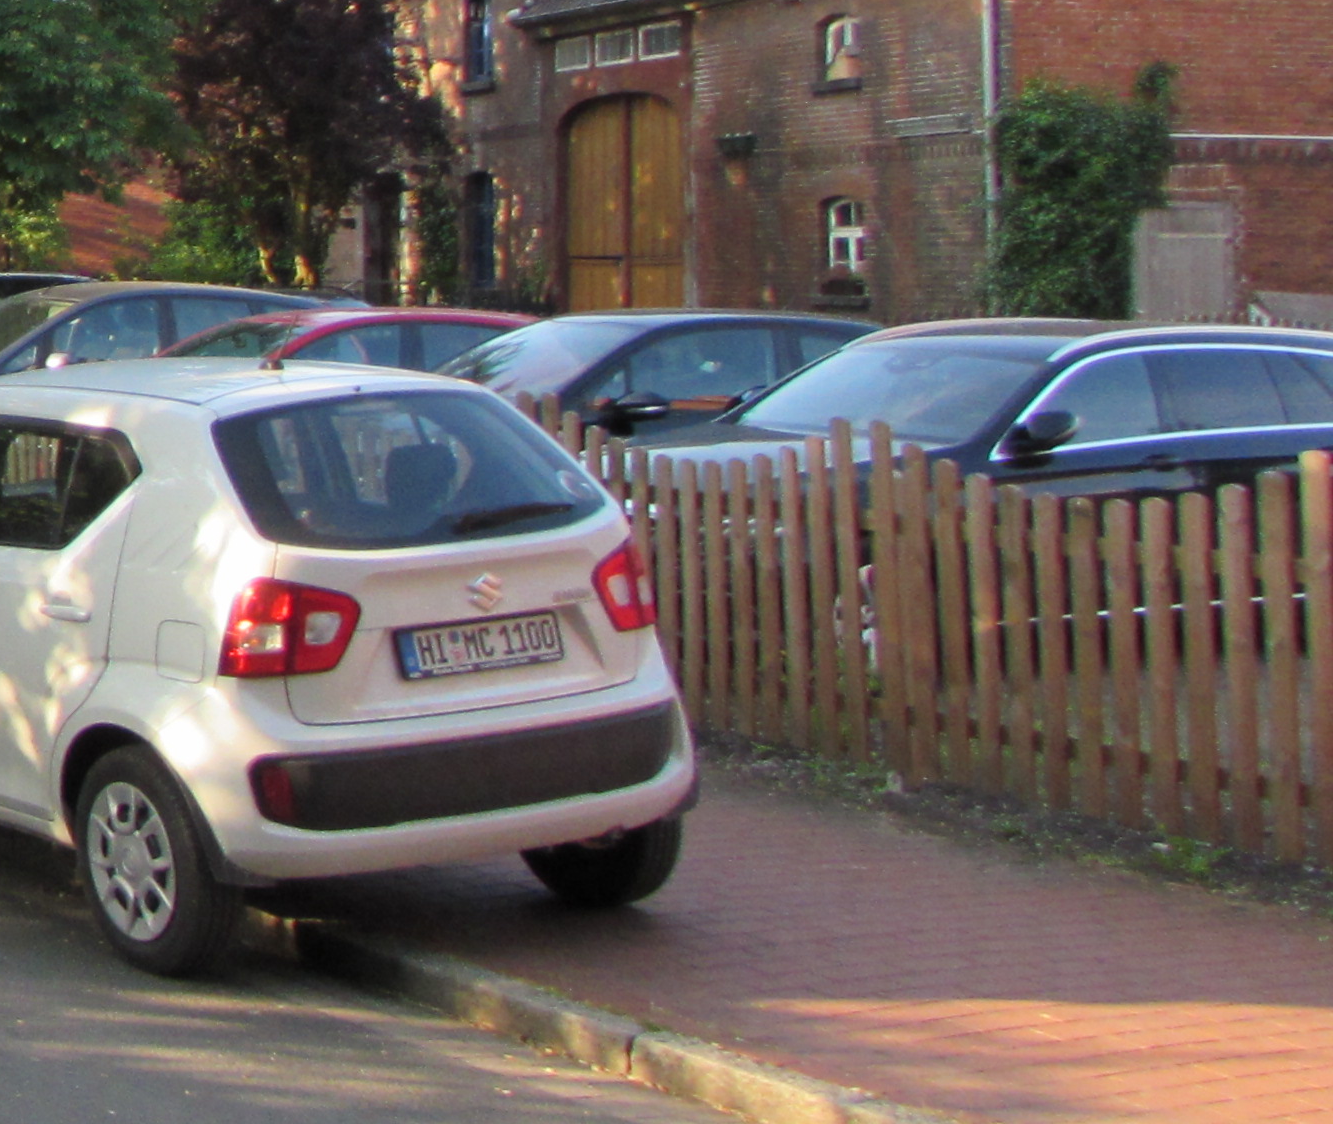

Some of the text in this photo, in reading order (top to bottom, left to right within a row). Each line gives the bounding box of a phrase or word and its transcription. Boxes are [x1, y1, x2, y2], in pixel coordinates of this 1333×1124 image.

[417, 619, 556, 666] HI MC 1100
